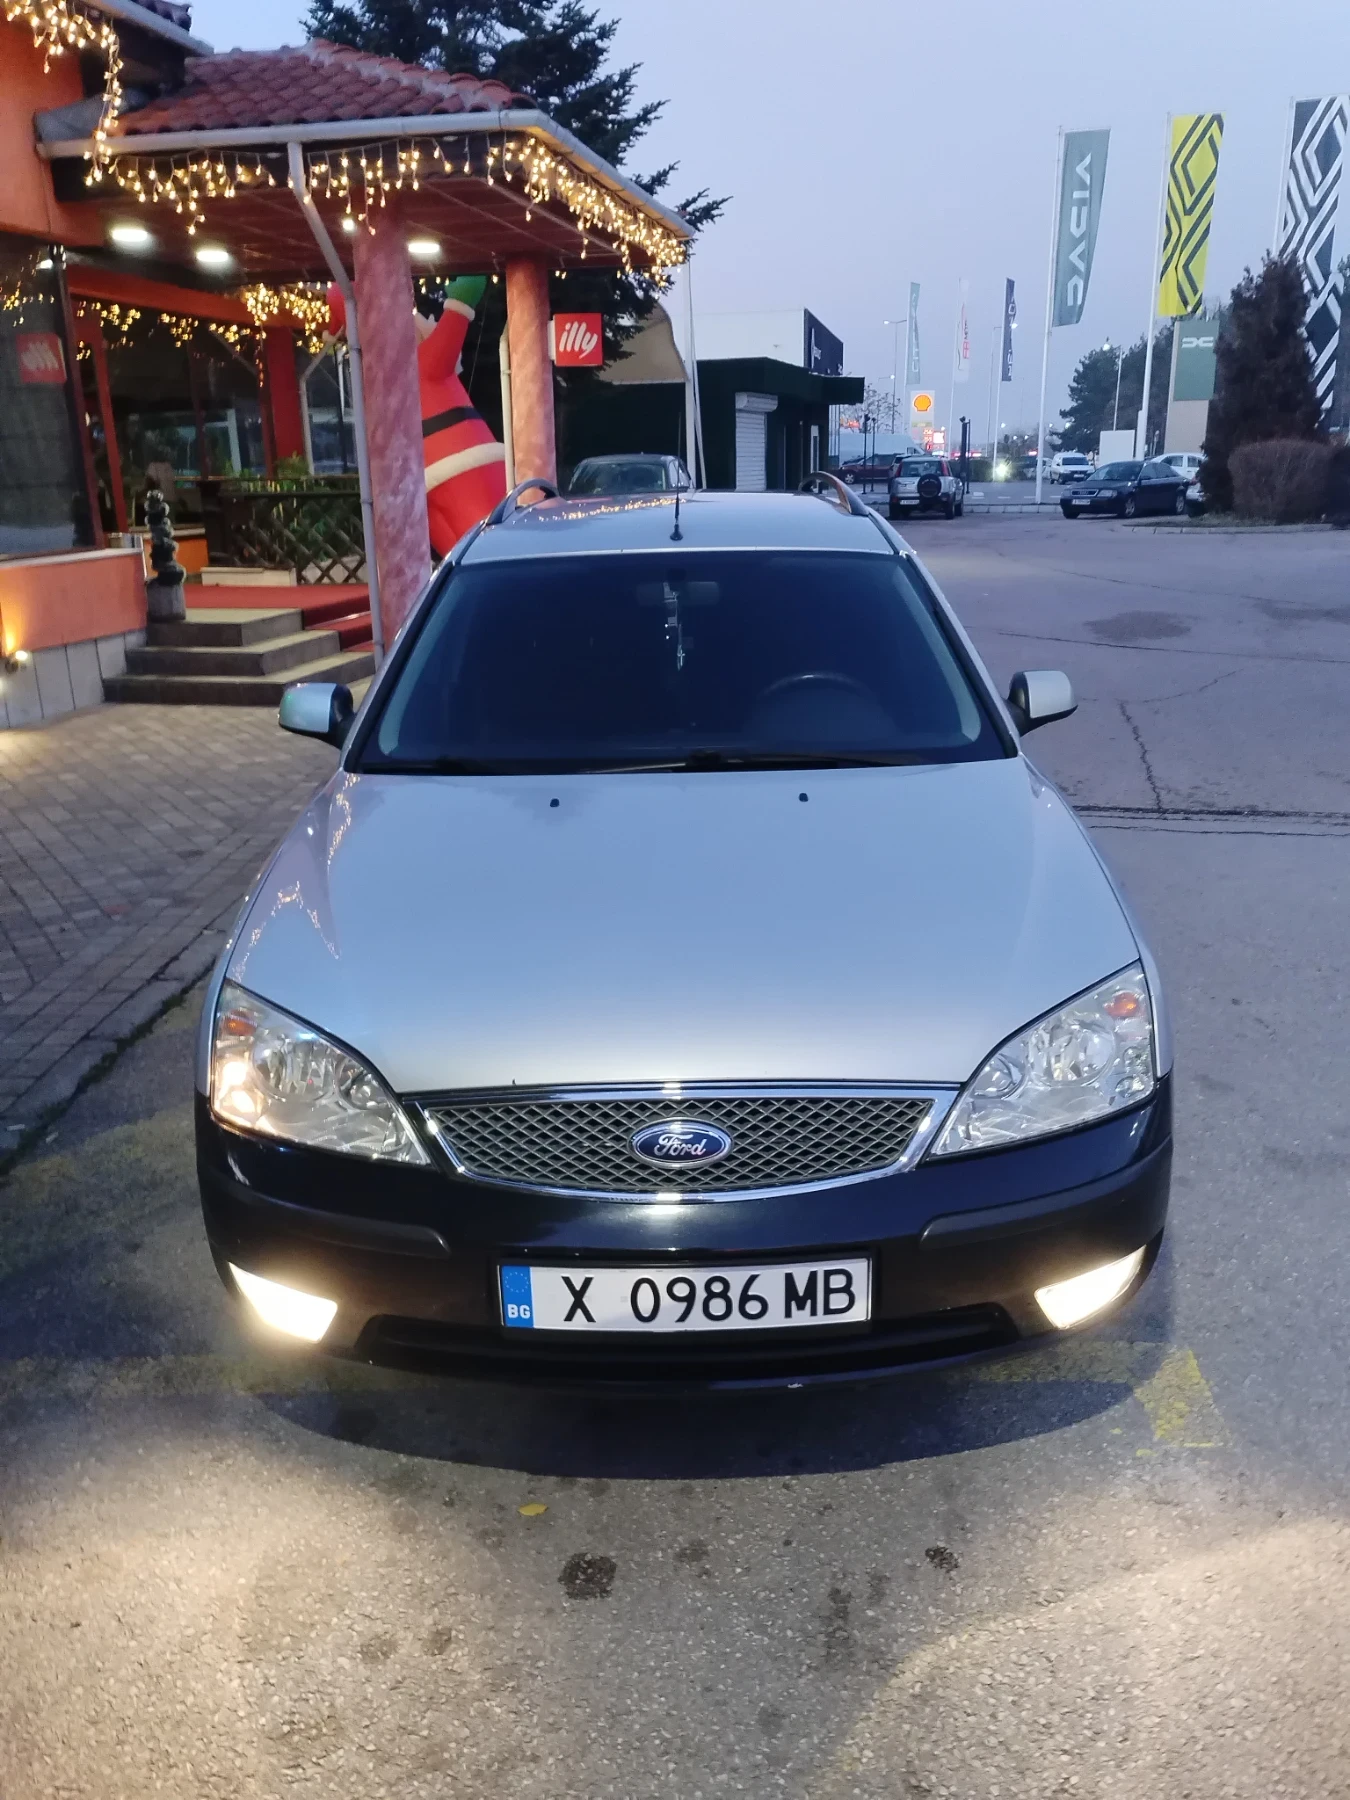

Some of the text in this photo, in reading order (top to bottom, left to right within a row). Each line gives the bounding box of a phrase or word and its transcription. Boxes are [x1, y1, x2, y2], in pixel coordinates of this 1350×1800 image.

[1067, 152, 1092, 307] DACIA
[558, 320, 599, 360] illy
[653, 1133, 708, 1158] Ford
[507, 1303, 531, 1319] BG
[561, 1268, 855, 1323] X 0986 MB
